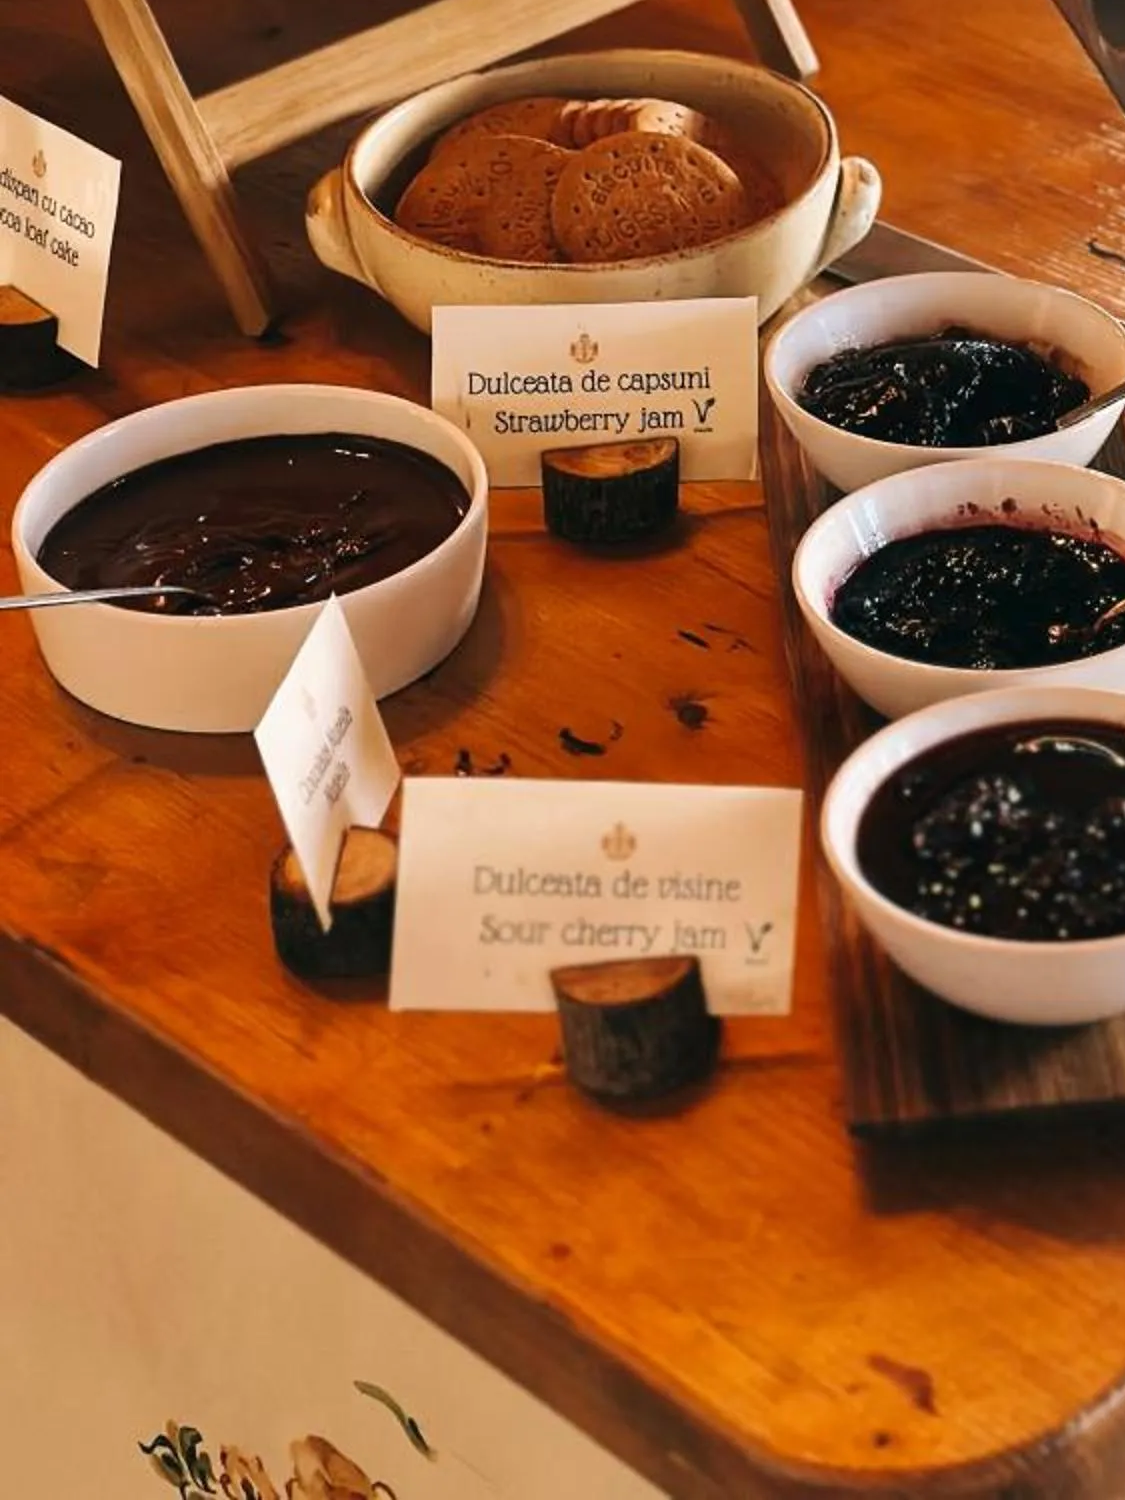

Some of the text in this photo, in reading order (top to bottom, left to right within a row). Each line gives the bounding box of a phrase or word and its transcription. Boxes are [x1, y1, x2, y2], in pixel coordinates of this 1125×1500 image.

[41, 195, 57, 216] cu
[60, 205, 95, 239] cacao
[24, 216, 48, 249] loaf
[50, 238, 79, 267] cake
[468, 366, 710, 396] Dulceata de capsuni
[494, 409, 630, 434] Strawberry
[637, 407, 684, 432] jam
[473, 866, 742, 902] Dulceata de visine
[479, 914, 551, 946] Sour
[560, 917, 662, 953] cherry
[670, 920, 727, 954] jam
